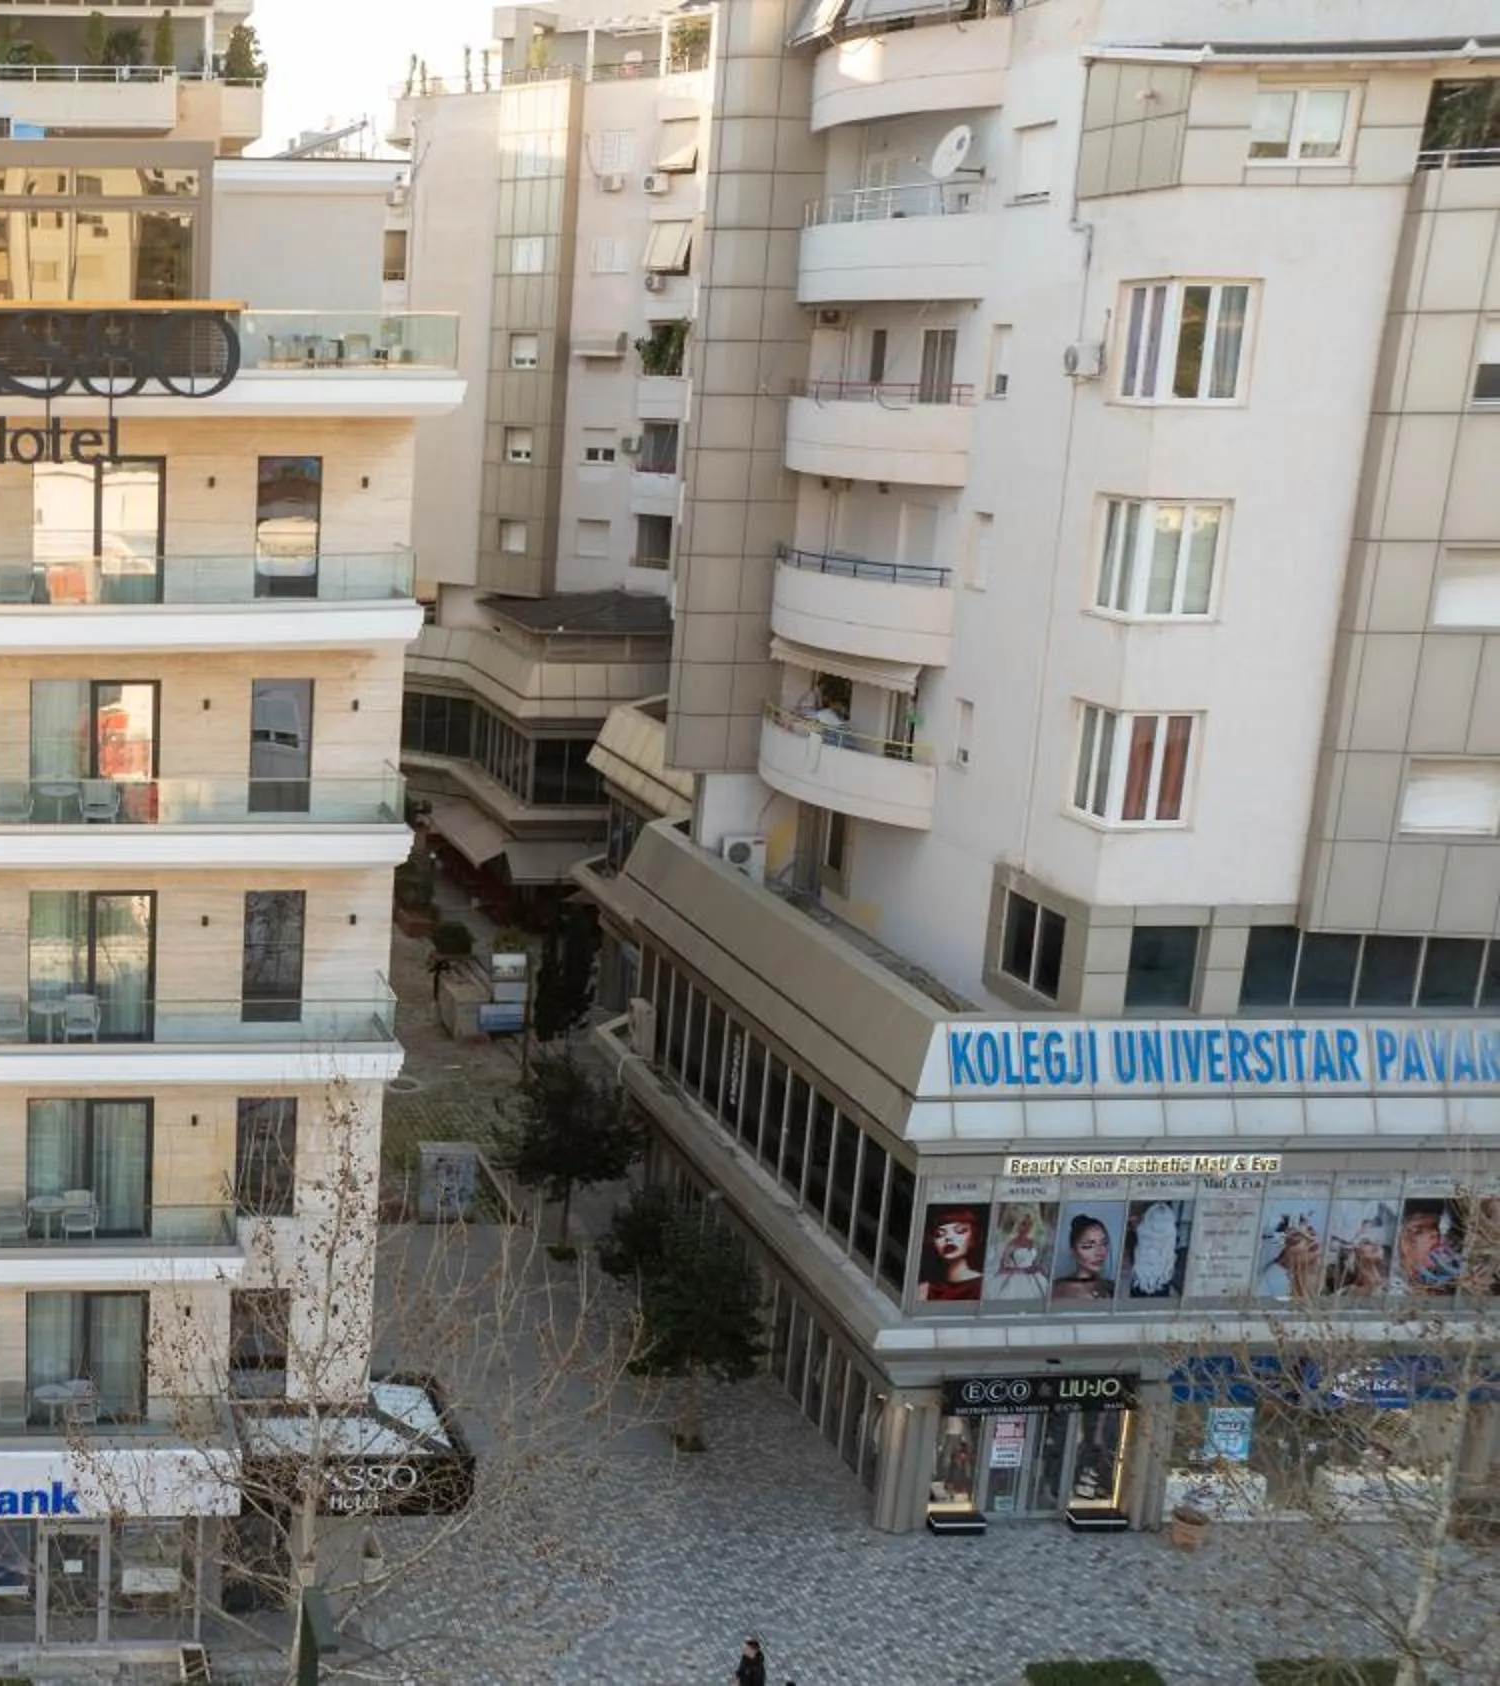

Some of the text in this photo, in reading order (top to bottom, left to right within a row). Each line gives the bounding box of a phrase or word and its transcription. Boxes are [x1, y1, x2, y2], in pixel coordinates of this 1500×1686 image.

[950, 1029, 1098, 1086] KOLEGJI
[1113, 1028, 1361, 1085] UNIVERSITAR
[1011, 1158, 1064, 1175] Beauty
[1069, 1158, 1113, 1173] Salon
[1235, 1156, 1247, 1171] &
[1252, 1156, 1278, 1171] Eva
[965, 1381, 1029, 1401] ECO
[297, 1464, 417, 1491] SSO
